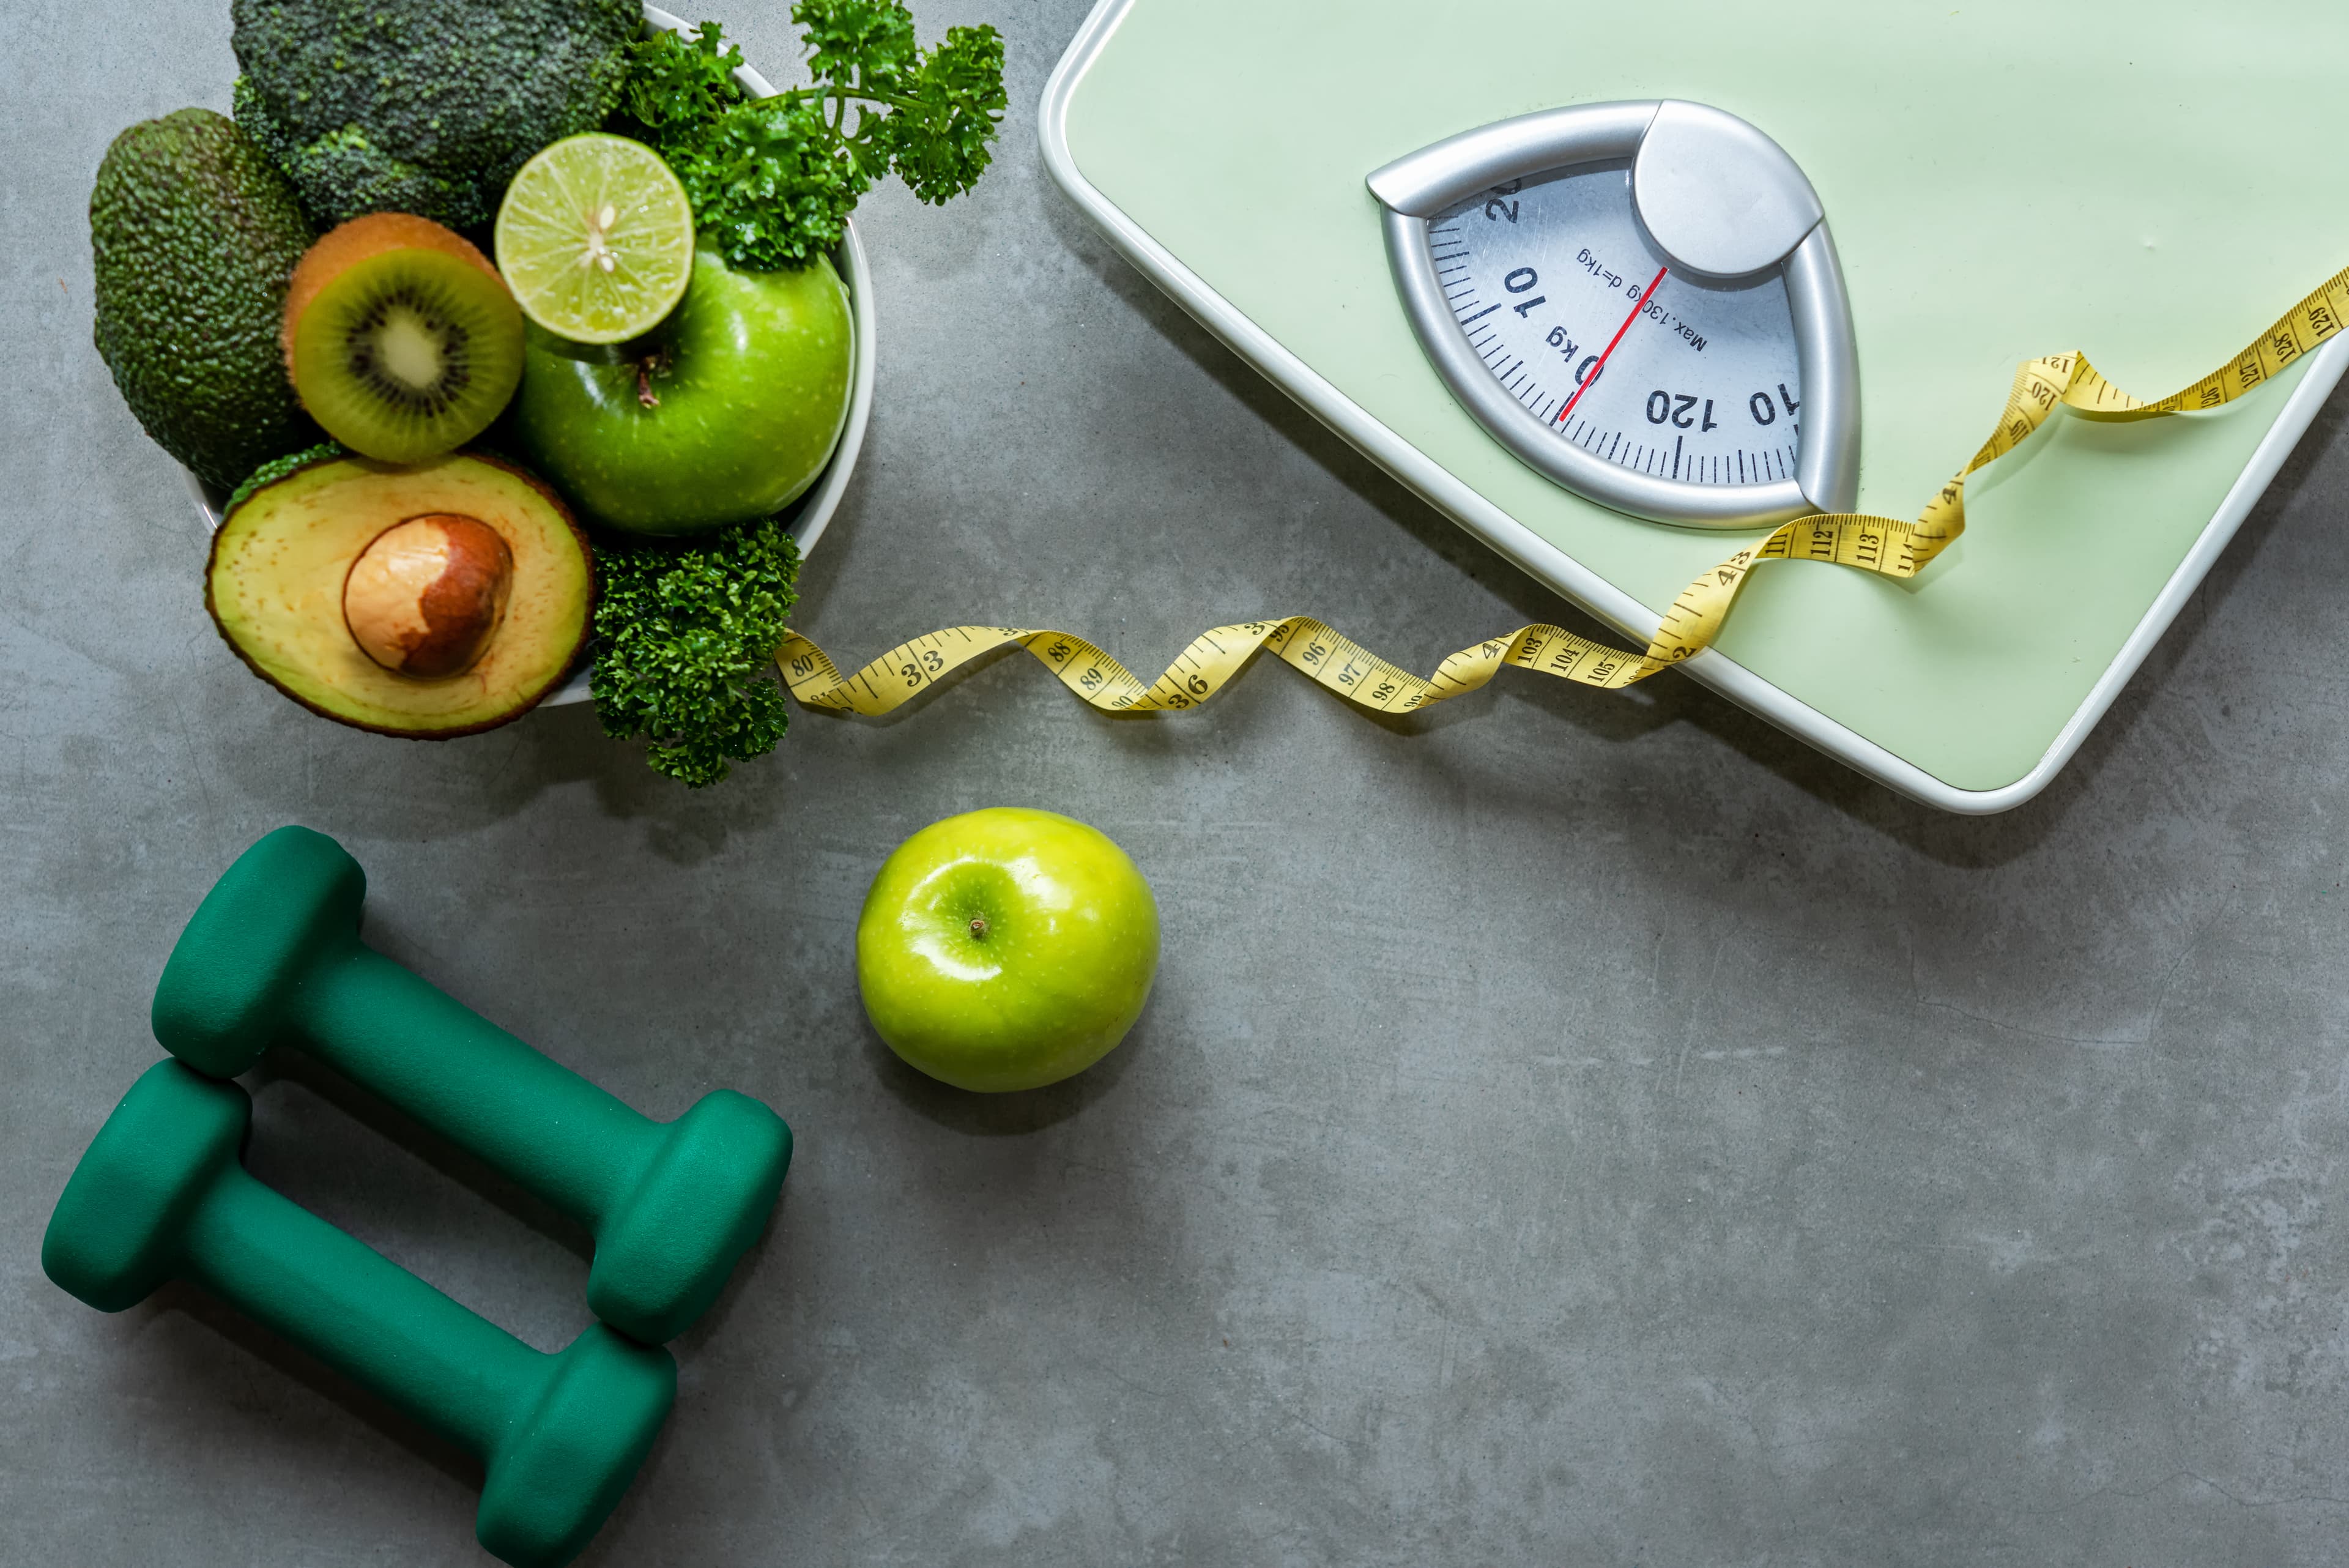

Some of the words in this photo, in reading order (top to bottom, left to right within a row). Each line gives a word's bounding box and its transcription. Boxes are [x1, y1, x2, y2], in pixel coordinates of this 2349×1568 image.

[1576, 248, 1622, 288] d=1kg
[1504, 267, 1546, 319] 10
[2309, 307, 2335, 337] 129
[1545, 325, 1579, 363] kg
[2274, 333, 2297, 363] 128
[1575, 355, 1605, 387] 0
[2239, 362, 2261, 389] 127
[2032, 381, 2057, 412] 120
[1646, 390, 1718, 433] 120
[1765, 532, 1789, 555] 111
[1810, 529, 1835, 557] 112
[1856, 533, 1880, 564] 113
[1047, 642, 1071, 663] 88
[1302, 642, 1326, 666] 96
[1517, 637, 1543, 663] 103
[1551, 647, 1580, 672] 104
[792, 655, 814, 677] 80
[1080, 667, 1104, 691] 89
[1338, 663, 1362, 686] 97
[1587, 661, 1616, 683] 105
[1111, 695, 1134, 708] 90
[1372, 682, 1395, 701] 98
